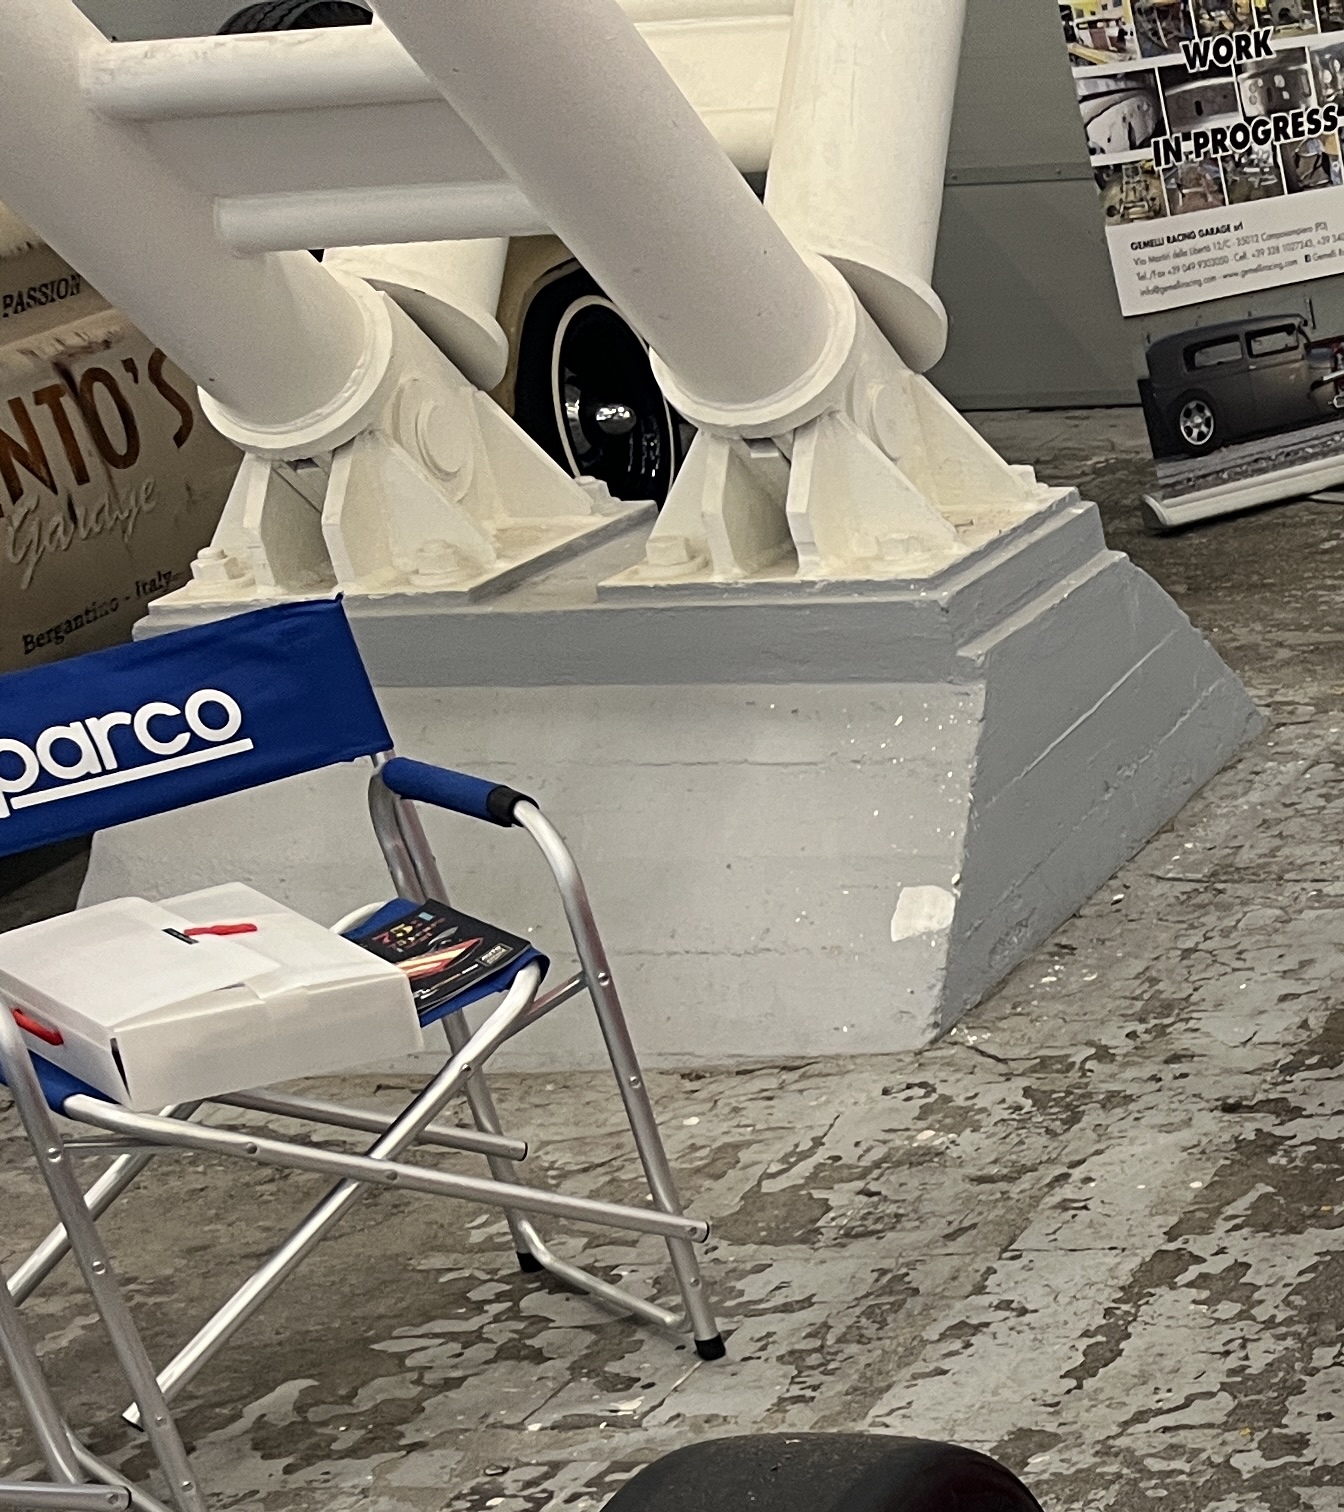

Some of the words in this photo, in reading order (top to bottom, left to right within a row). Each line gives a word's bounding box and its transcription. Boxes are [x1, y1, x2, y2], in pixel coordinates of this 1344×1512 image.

[1183, 29, 1274, 71] WORK
[1152, 134, 1184, 168] IN
[1190, 106, 1339, 159] PROGRESS
[1131, 237, 1164, 250] GEMELLI
[1167, 231, 1196, 244] RACING
[1198, 224, 1231, 237] GARAGE
[3, 274, 81, 318] PASSION
[0, 347, 194, 517] NTO'S
[134, 570, 173, 597] Italy
